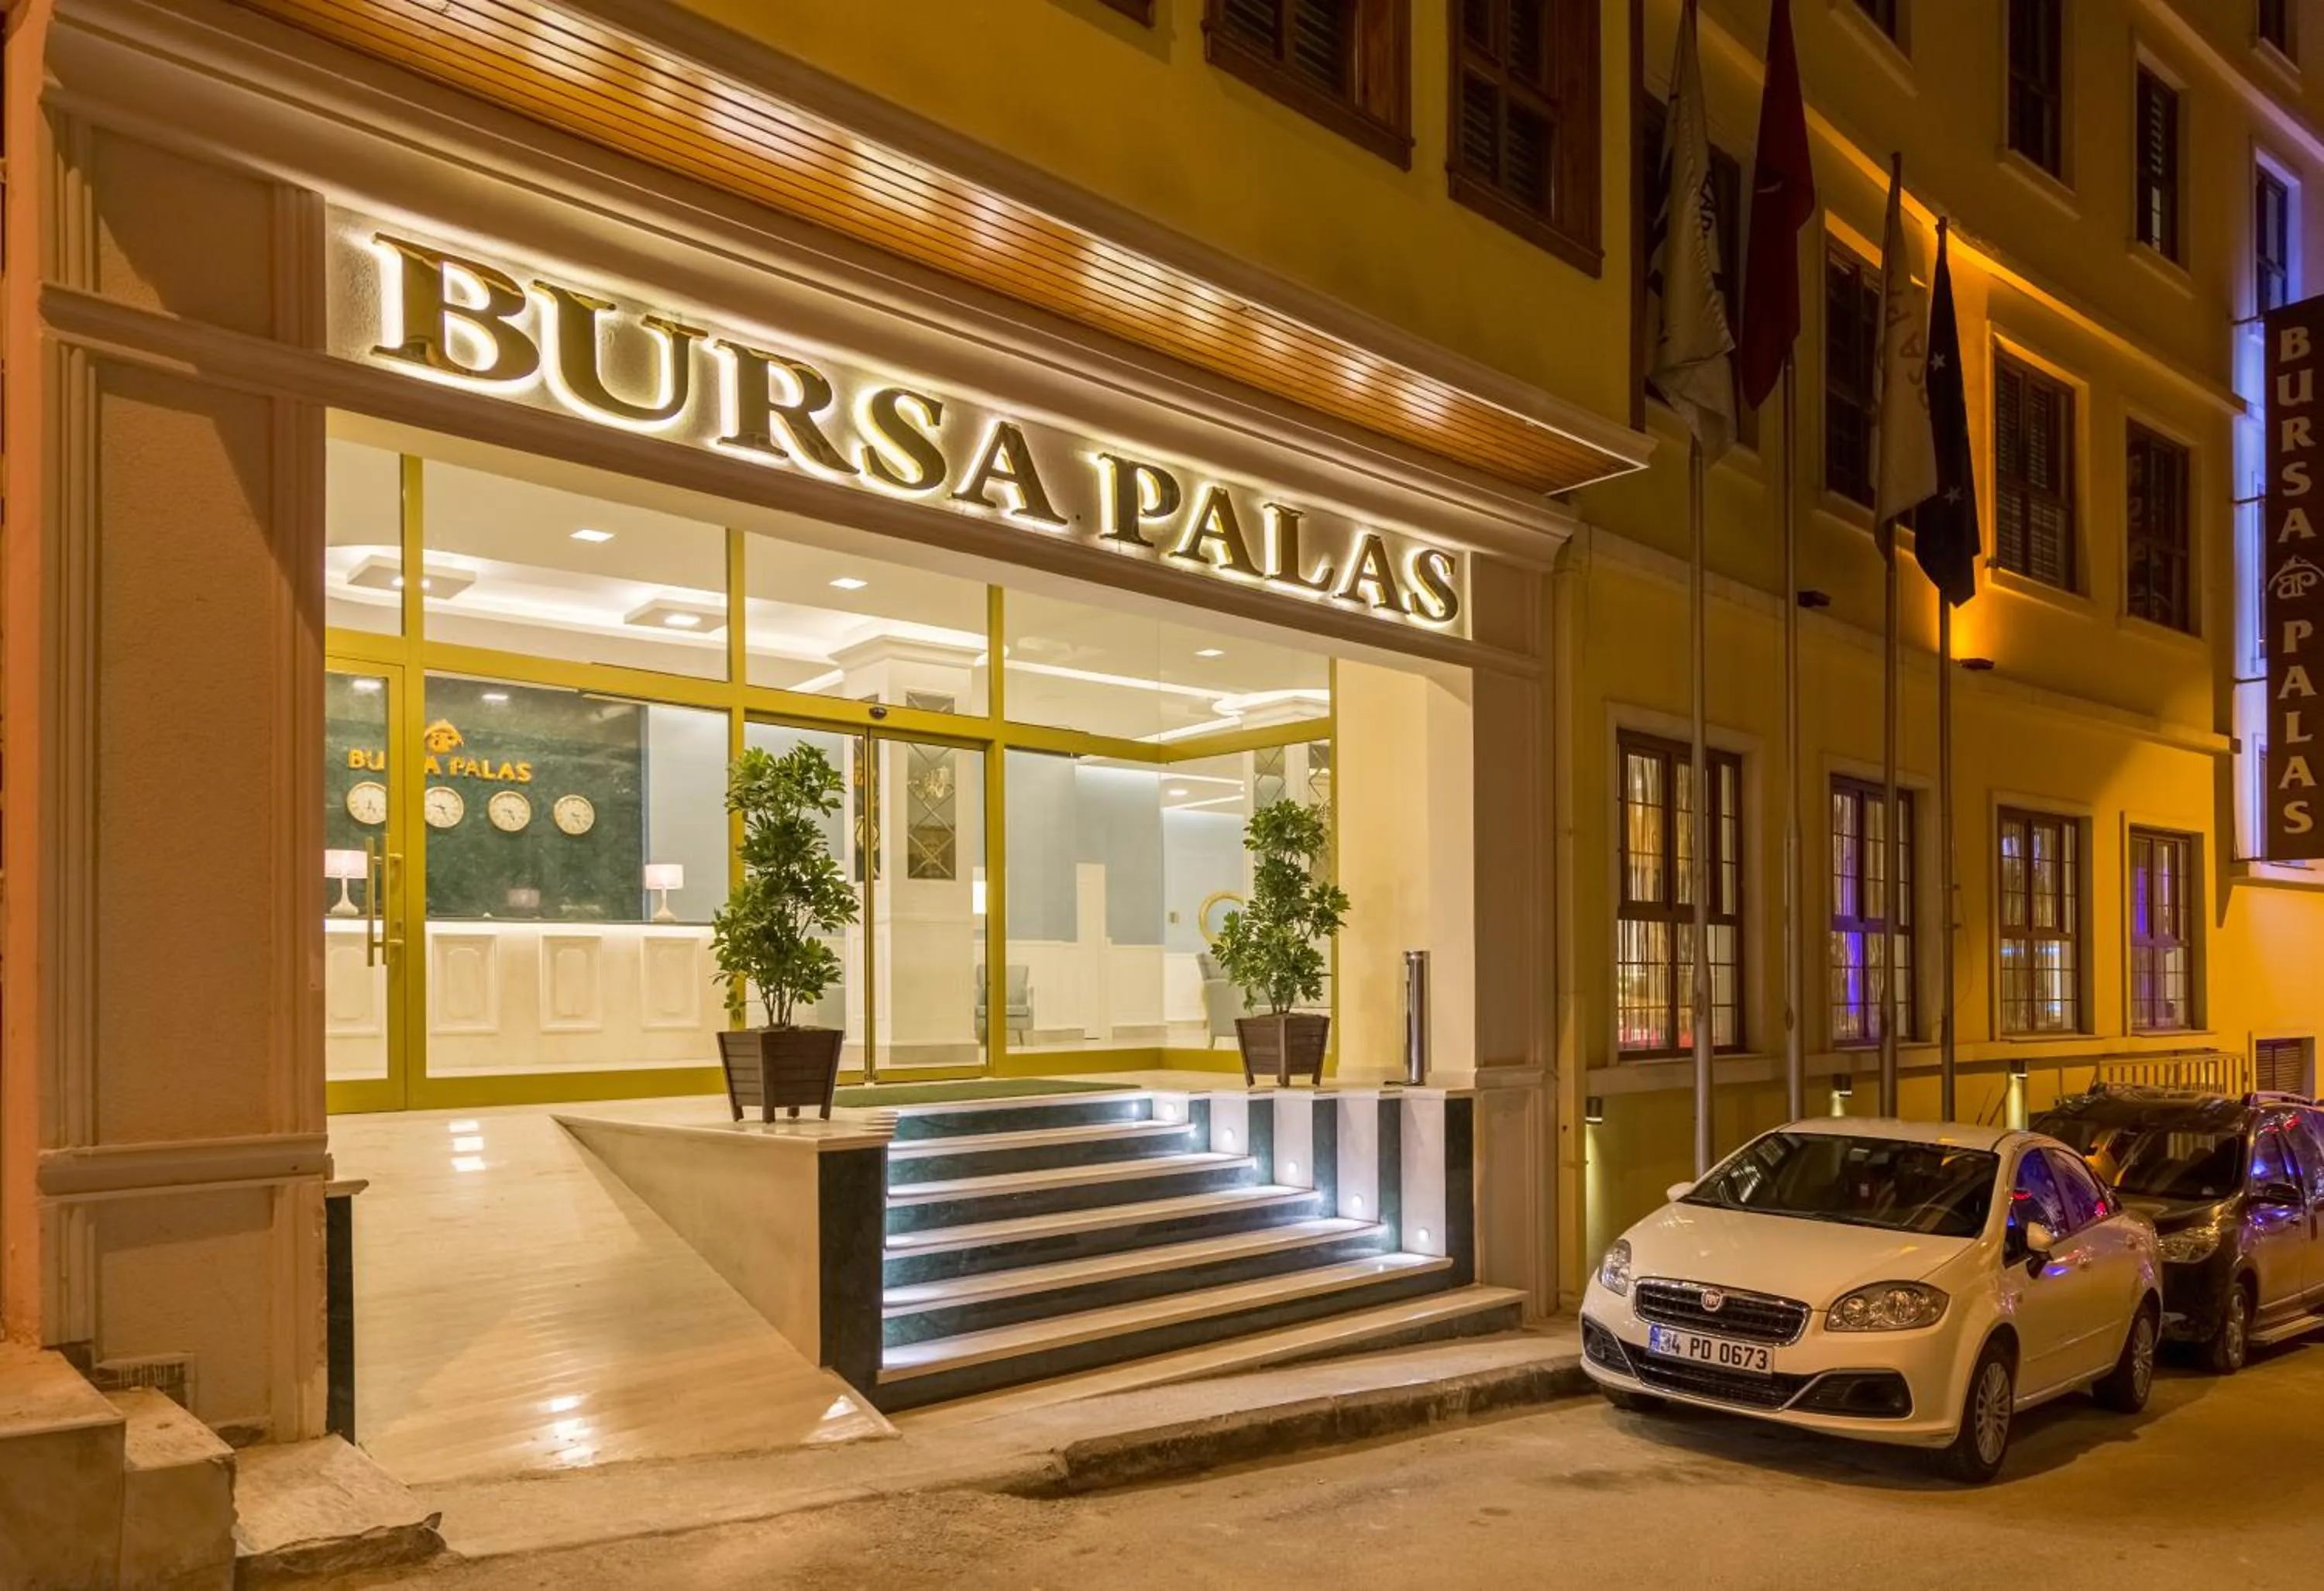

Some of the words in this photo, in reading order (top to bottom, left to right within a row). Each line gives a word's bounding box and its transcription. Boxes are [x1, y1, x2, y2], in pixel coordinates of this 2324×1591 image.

[370, 232, 1067, 527] BURSA
[1097, 452, 1459, 624] PALAS
[2276, 326, 2317, 543] BURSA
[347, 748, 441, 775] BUA
[449, 756, 533, 783] PALAS
[2277, 619, 2318, 834] PALAS
[1690, 1336, 1711, 1360] PD
[1719, 1342, 1767, 1370] 0673
